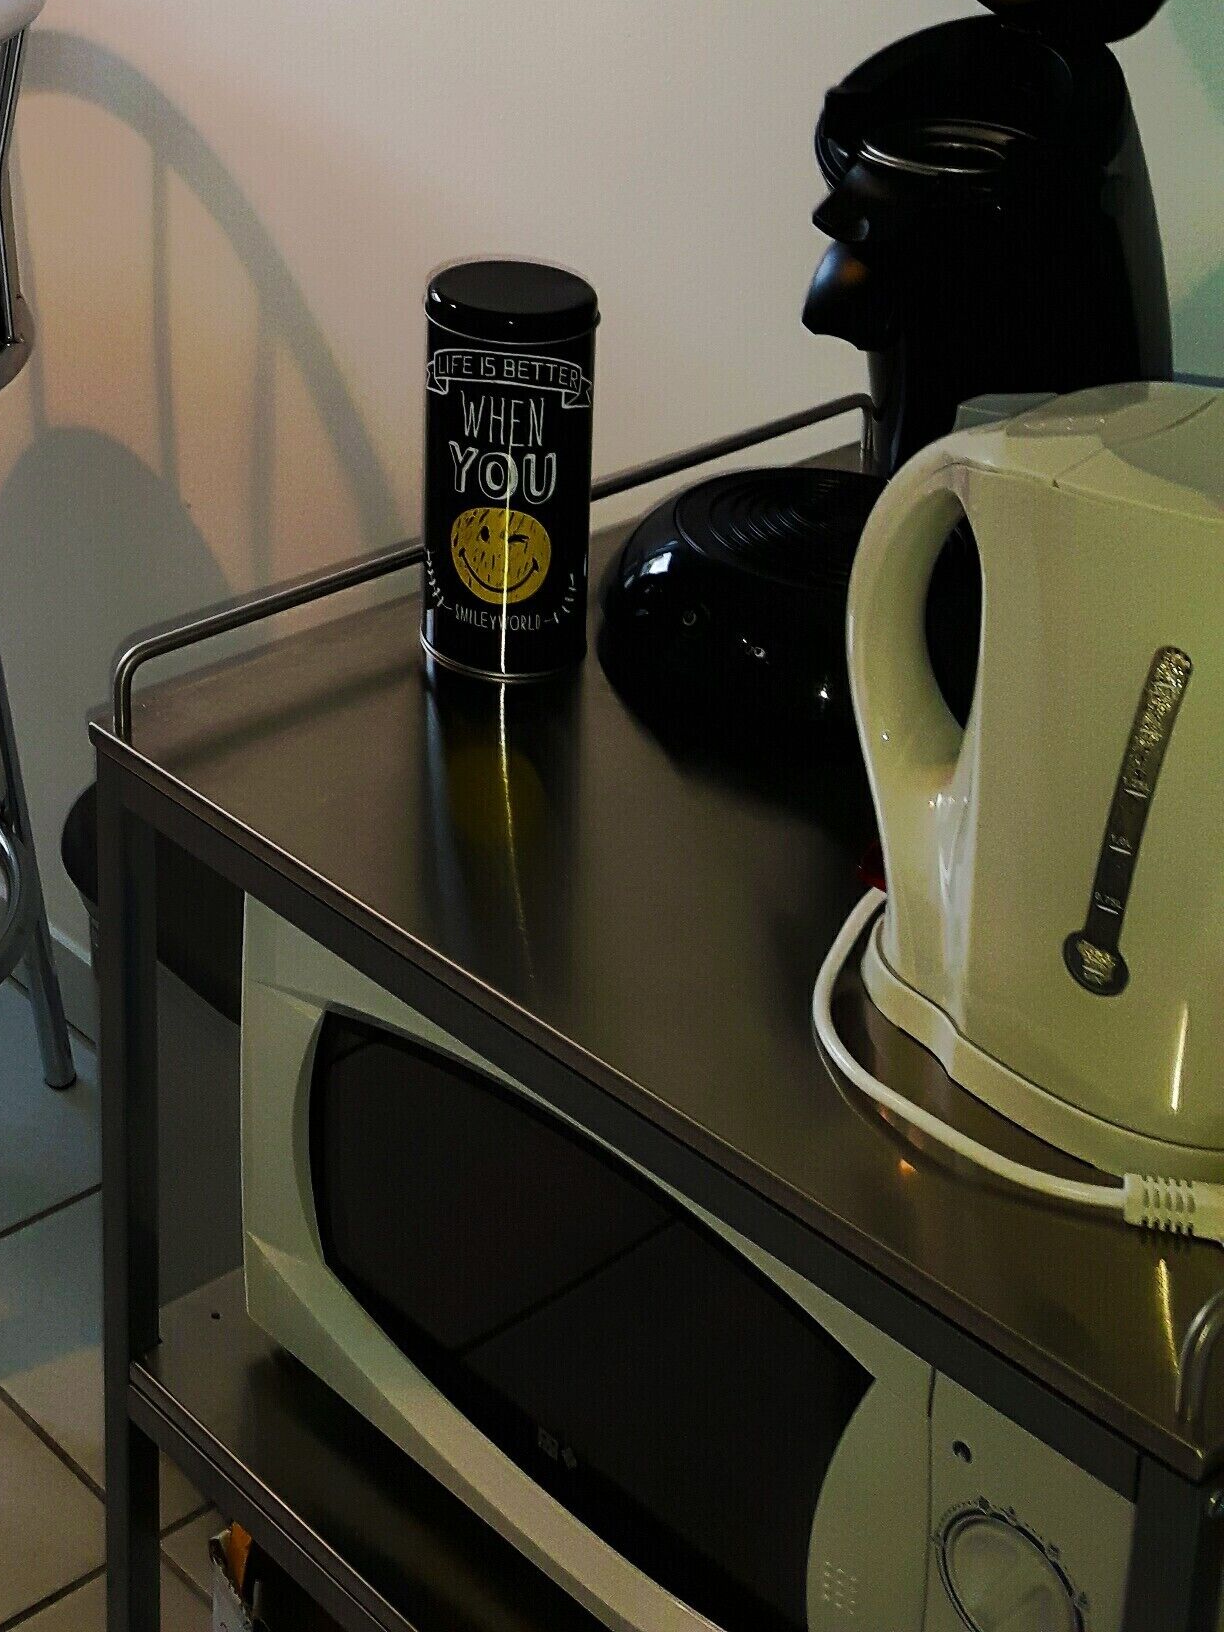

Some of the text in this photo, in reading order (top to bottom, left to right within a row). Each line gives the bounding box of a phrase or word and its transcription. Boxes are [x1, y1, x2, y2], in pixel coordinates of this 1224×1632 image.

[438, 355, 578, 389] LIFE IS BETTER
[460, 389, 545, 447] WHEN
[448, 439, 557, 505] YOU
